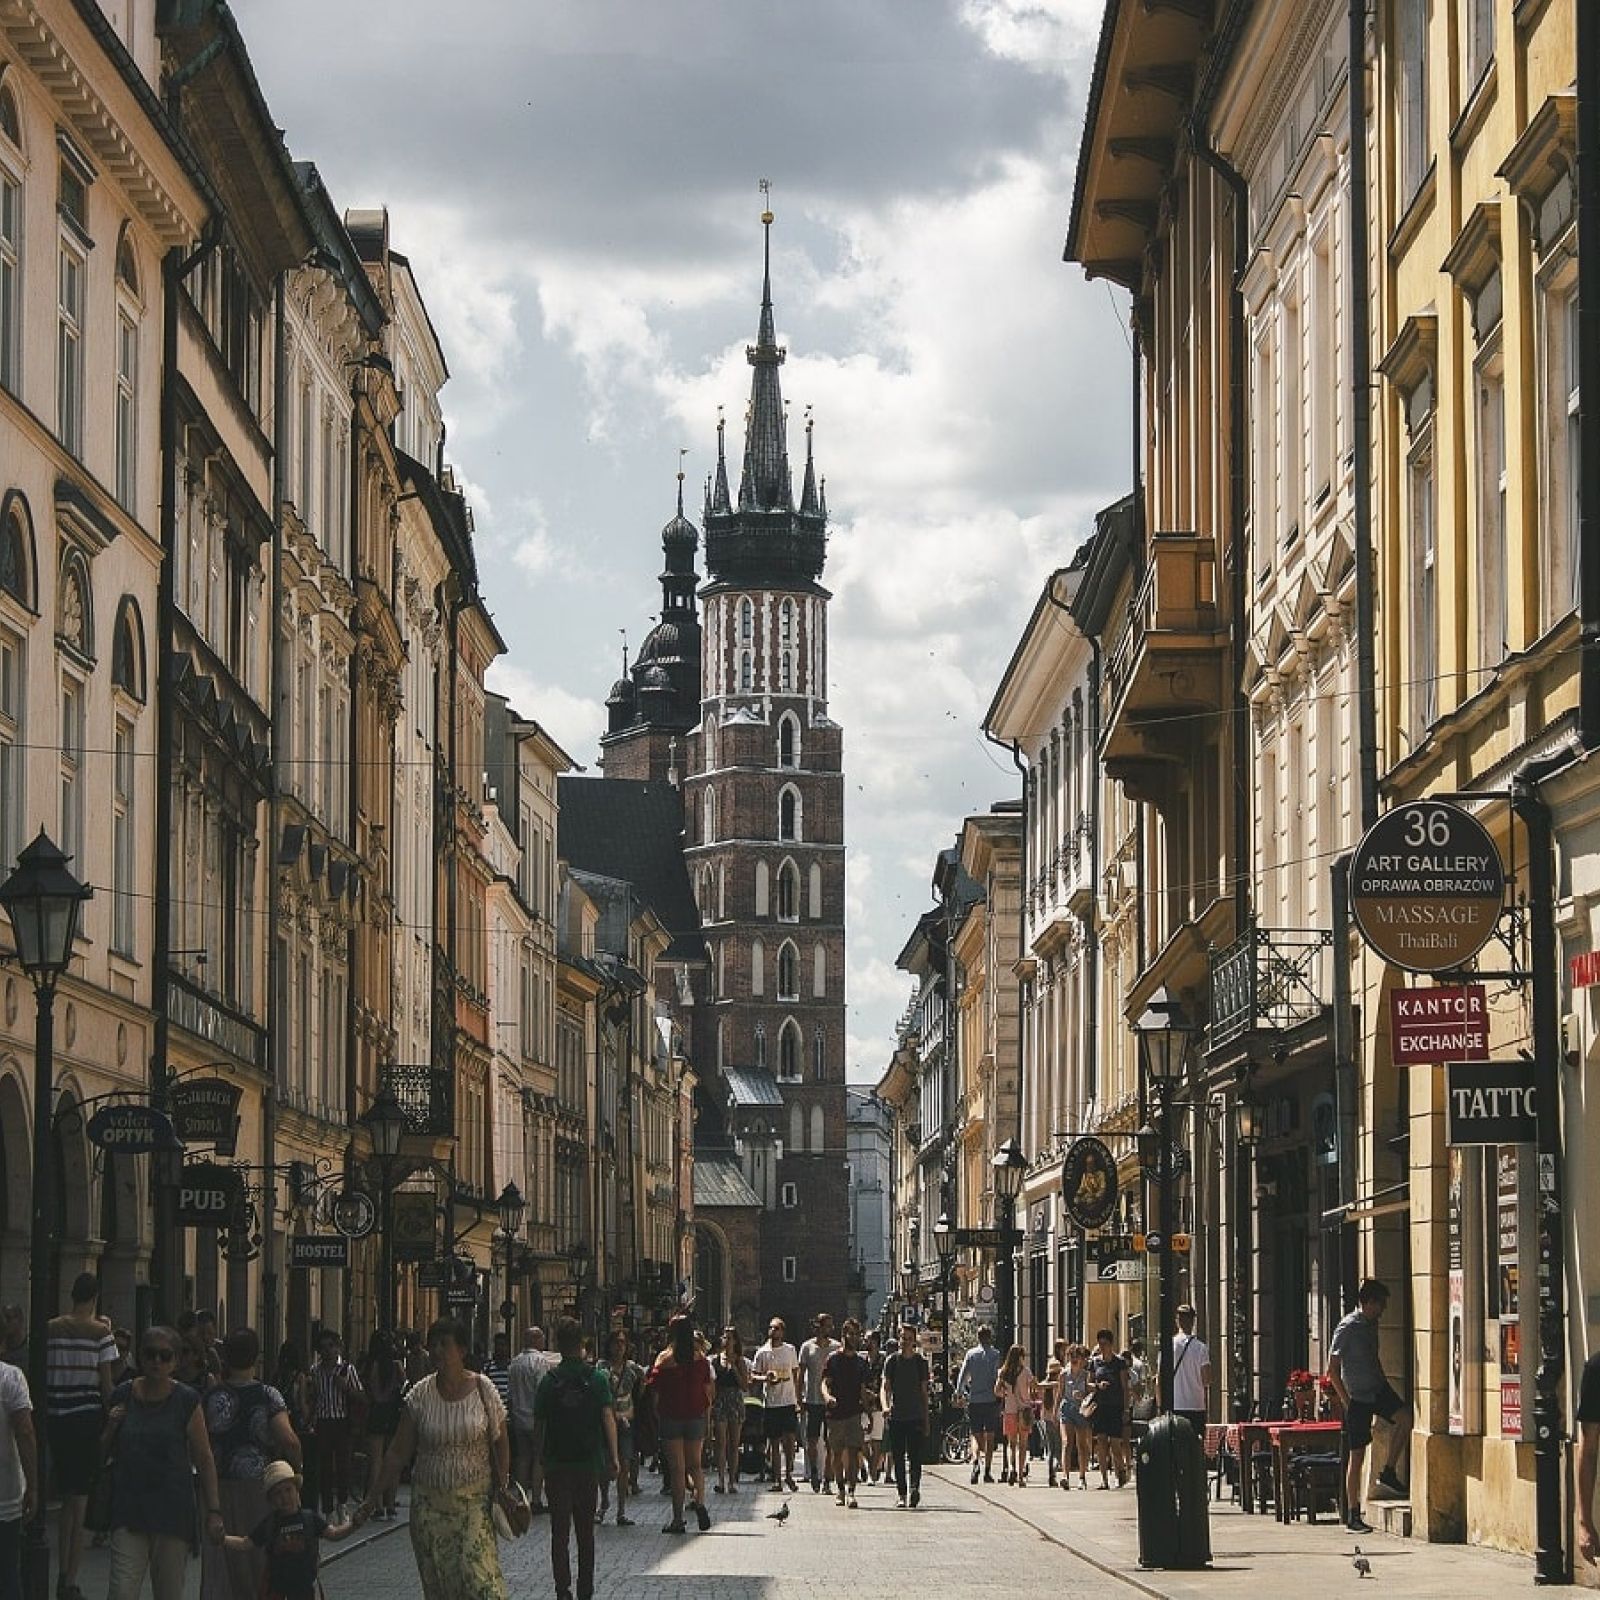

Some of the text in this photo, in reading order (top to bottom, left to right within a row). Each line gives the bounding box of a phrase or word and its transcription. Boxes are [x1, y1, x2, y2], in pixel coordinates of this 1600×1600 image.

[1404, 810, 1449, 846] 36
[1366, 856, 1488, 872] ART GALLERY
[1361, 877, 1495, 892] OPRAWA OBRAZÓW
[1376, 906, 1479, 924] MASSAGE
[1398, 932, 1457, 949] ThaiBali
[1397, 997, 1480, 1016] KANTOR
[1400, 1032, 1483, 1052] EXCHANGE
[103, 1129, 154, 1144] OPTYK
[179, 1189, 226, 1210] PUB
[294, 1244, 344, 1258] HOSTEL
